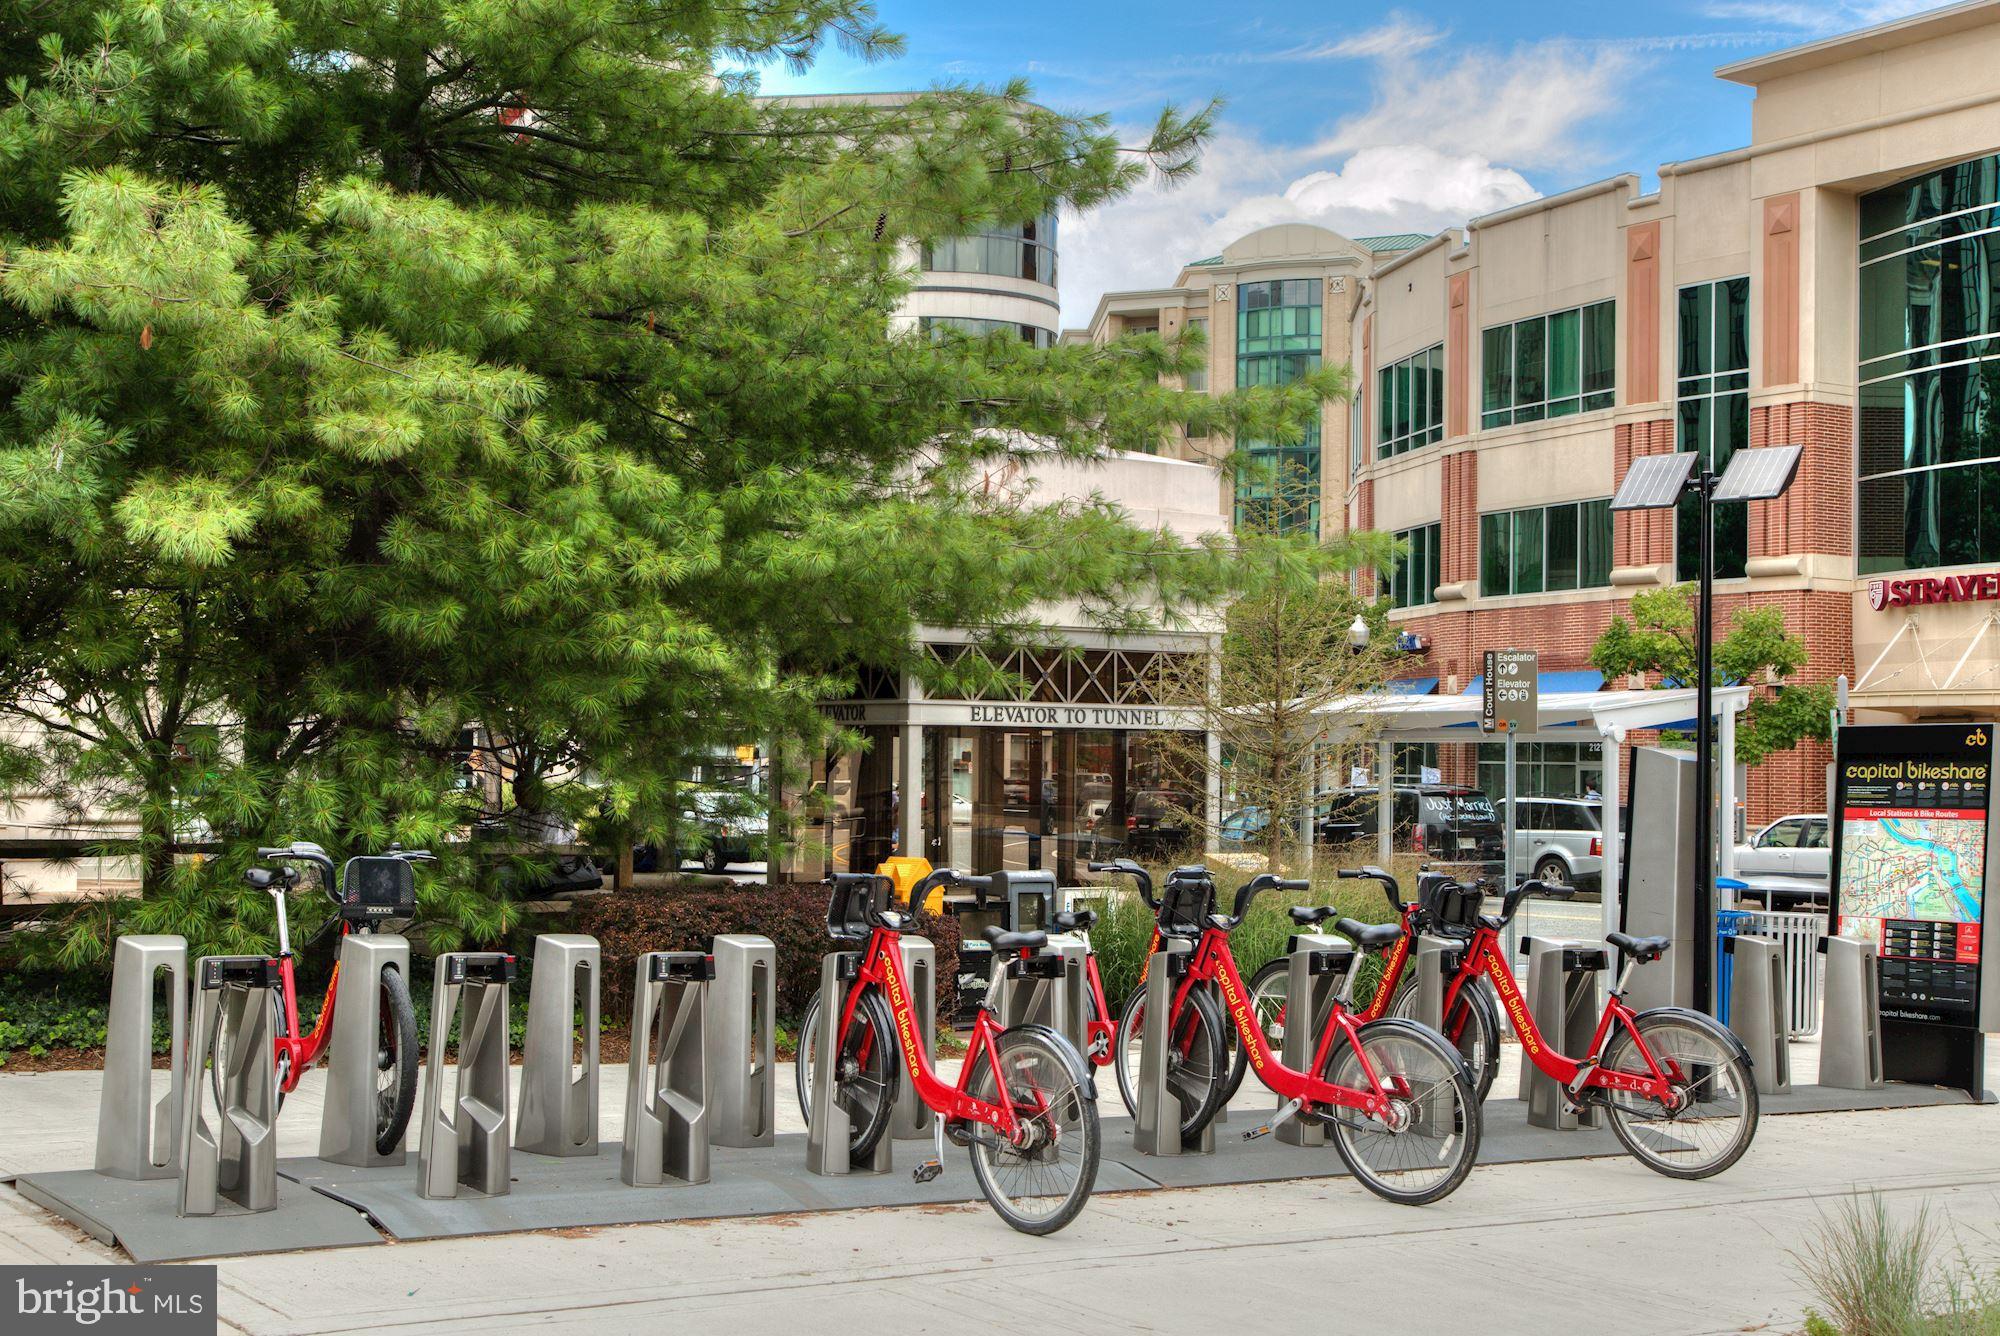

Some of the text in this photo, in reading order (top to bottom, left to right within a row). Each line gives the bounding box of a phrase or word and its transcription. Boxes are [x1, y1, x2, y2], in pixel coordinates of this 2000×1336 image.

[1485, 653, 1493, 686] House
[1497, 653, 1536, 662] Escalator
[1497, 680, 1531, 688] Elevator
[1485, 687, 1493, 716] Court
[970, 705, 1165, 727] ELEVATOR TO TUNNEL
[1846, 760, 1985, 783] capital bikeshare
[1426, 797, 1495, 812] Just Married
[1869, 809, 1959, 819] Local Stations & Bike Routes
[1370, 936, 1407, 1018] capital bikeshare
[884, 957, 920, 1078] capital bikeshare
[1487, 954, 1539, 1055] capital bikeshare
[1235, 1005, 1264, 1069] bikeshare
